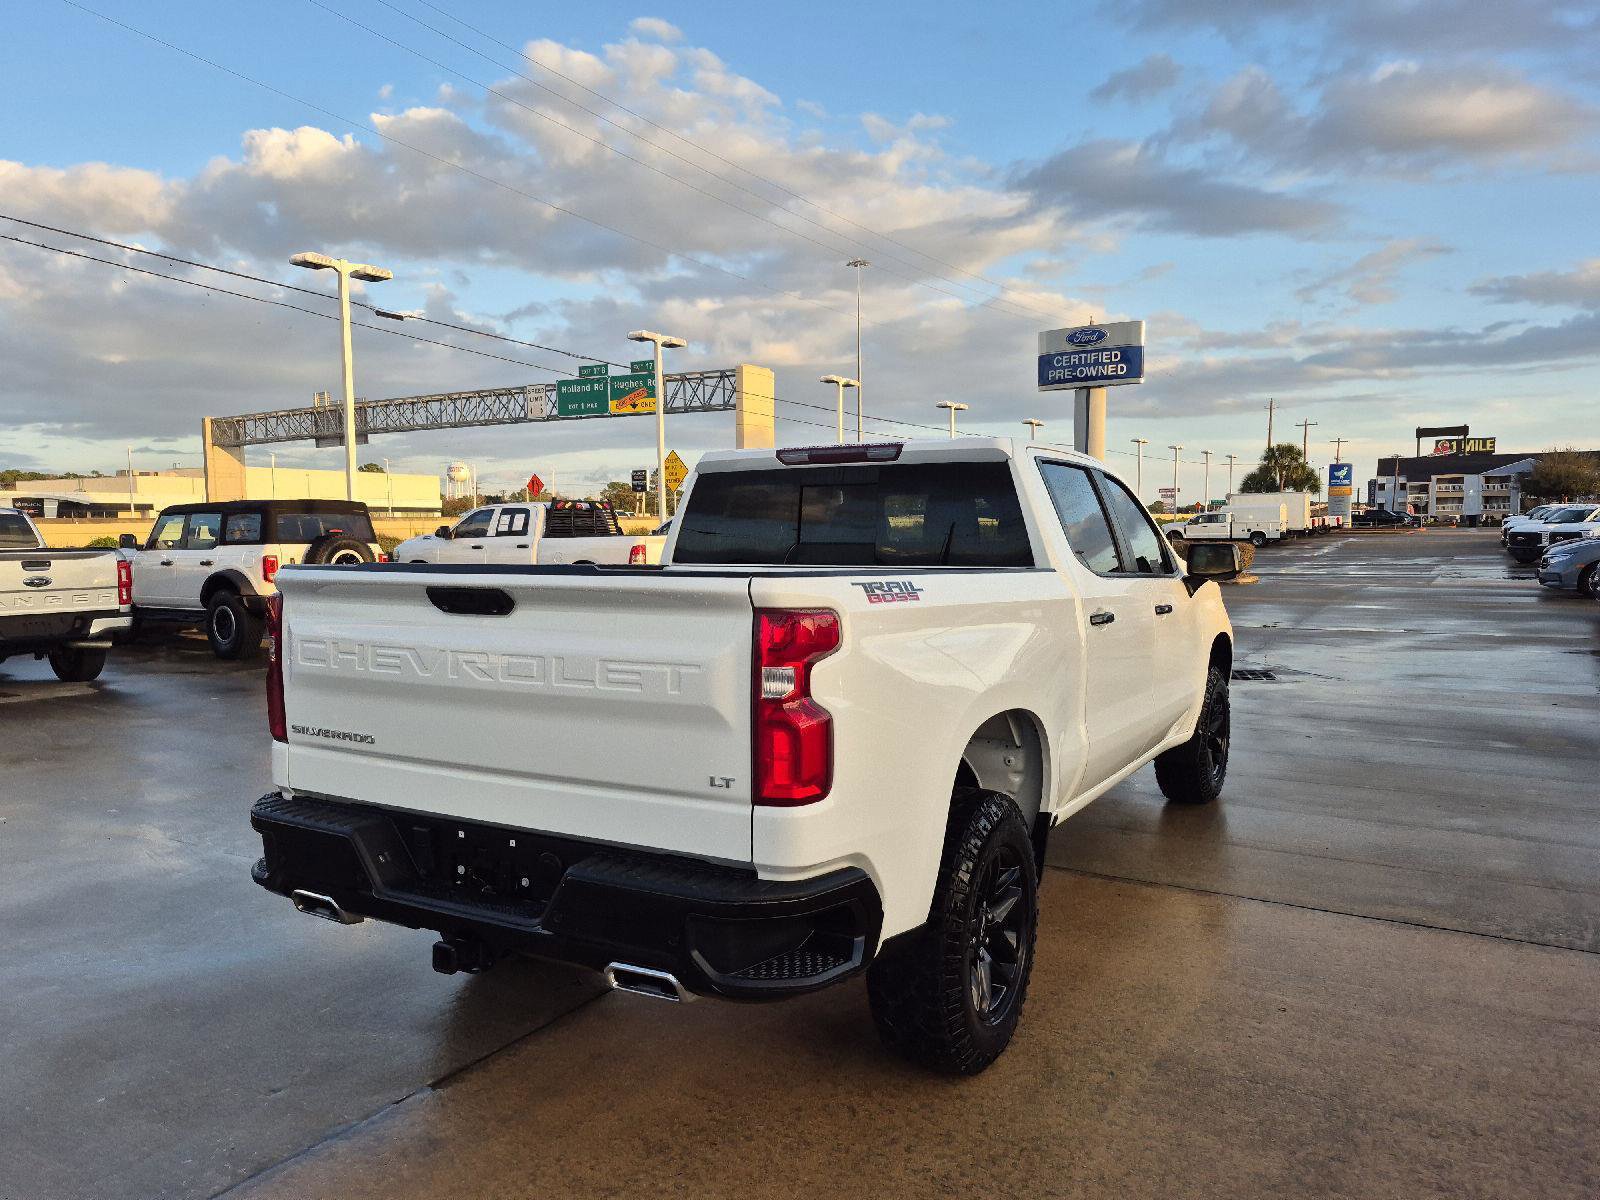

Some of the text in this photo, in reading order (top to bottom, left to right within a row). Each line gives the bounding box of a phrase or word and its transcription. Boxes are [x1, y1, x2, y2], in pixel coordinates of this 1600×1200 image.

[1073, 331, 1099, 343] Ford
[1053, 350, 1121, 367] CERTIFIED
[1048, 363, 1127, 381] PRE-OWNED
[561, 383, 604, 394] Holland Rd
[614, 380, 644, 389] Hughes
[1461, 438, 1495, 453] MILE
[851, 581, 924, 594] TRAIL
[866, 591, 921, 604] BOSS
[299, 640, 702, 695] CHEVROLET
[291, 724, 376, 745] SILVERADO
[709, 775, 736, 788] LT
